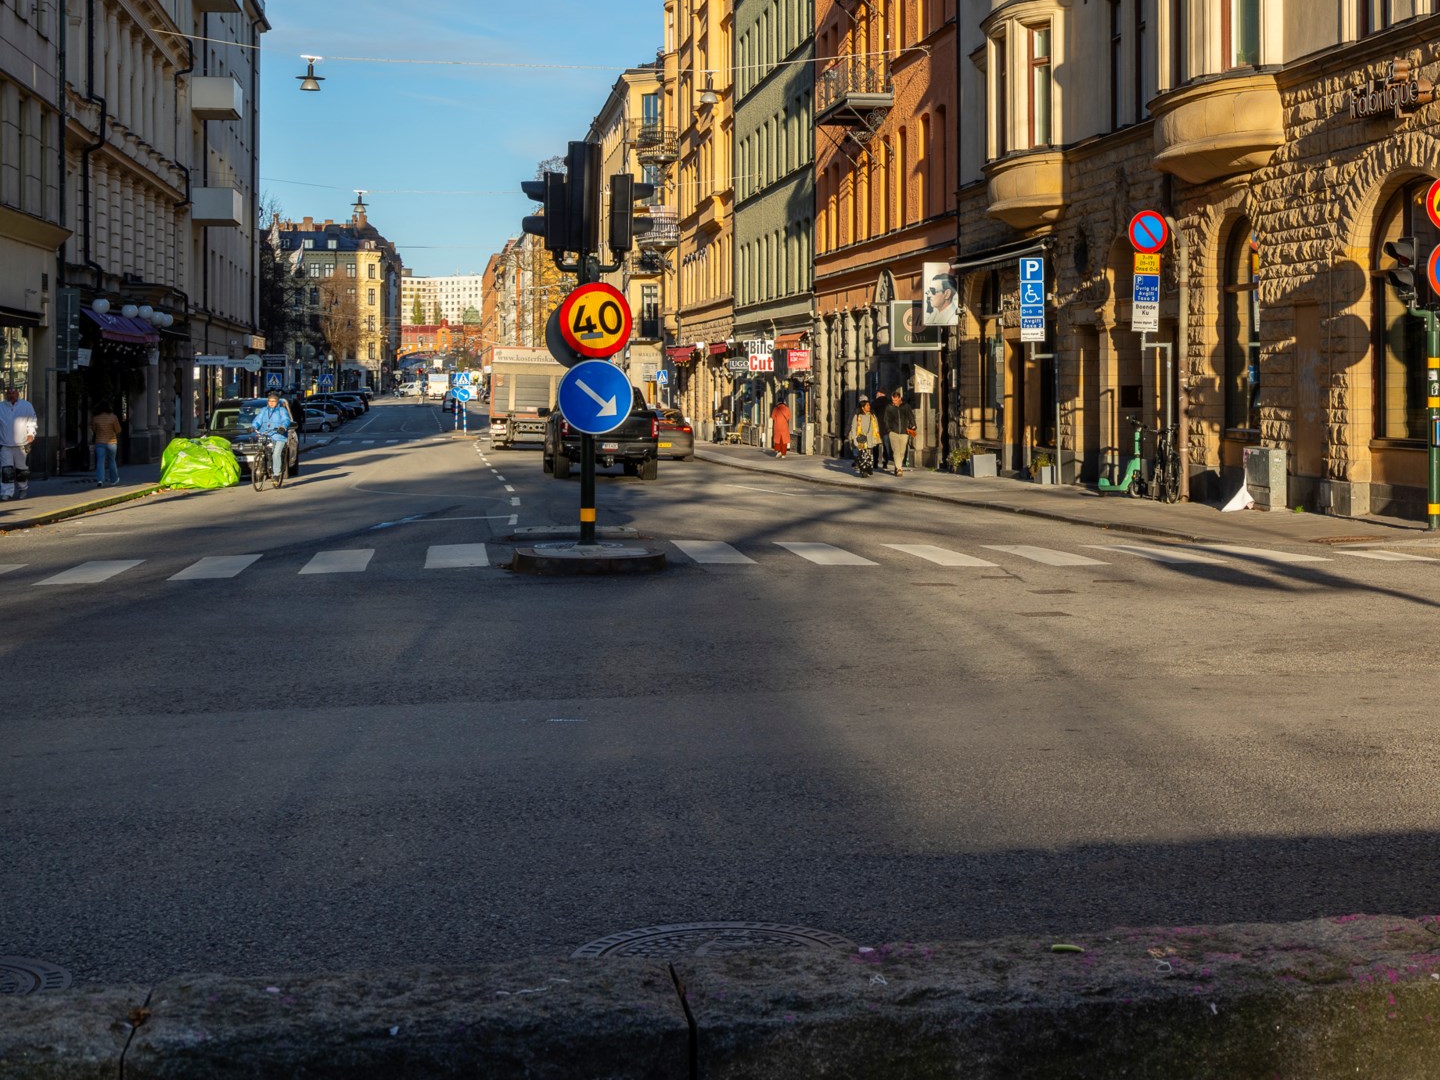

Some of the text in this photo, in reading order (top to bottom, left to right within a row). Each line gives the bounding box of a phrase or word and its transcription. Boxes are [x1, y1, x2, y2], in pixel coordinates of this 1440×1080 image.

[1350, 62, 1418, 119] Fabrique
[1026, 260, 1039, 280] P
[573, 300, 623, 335] 40
[749, 340, 773, 355] Bills
[498, 354, 557, 363] www.kosterfiskar
[749, 355, 773, 371] Cut
